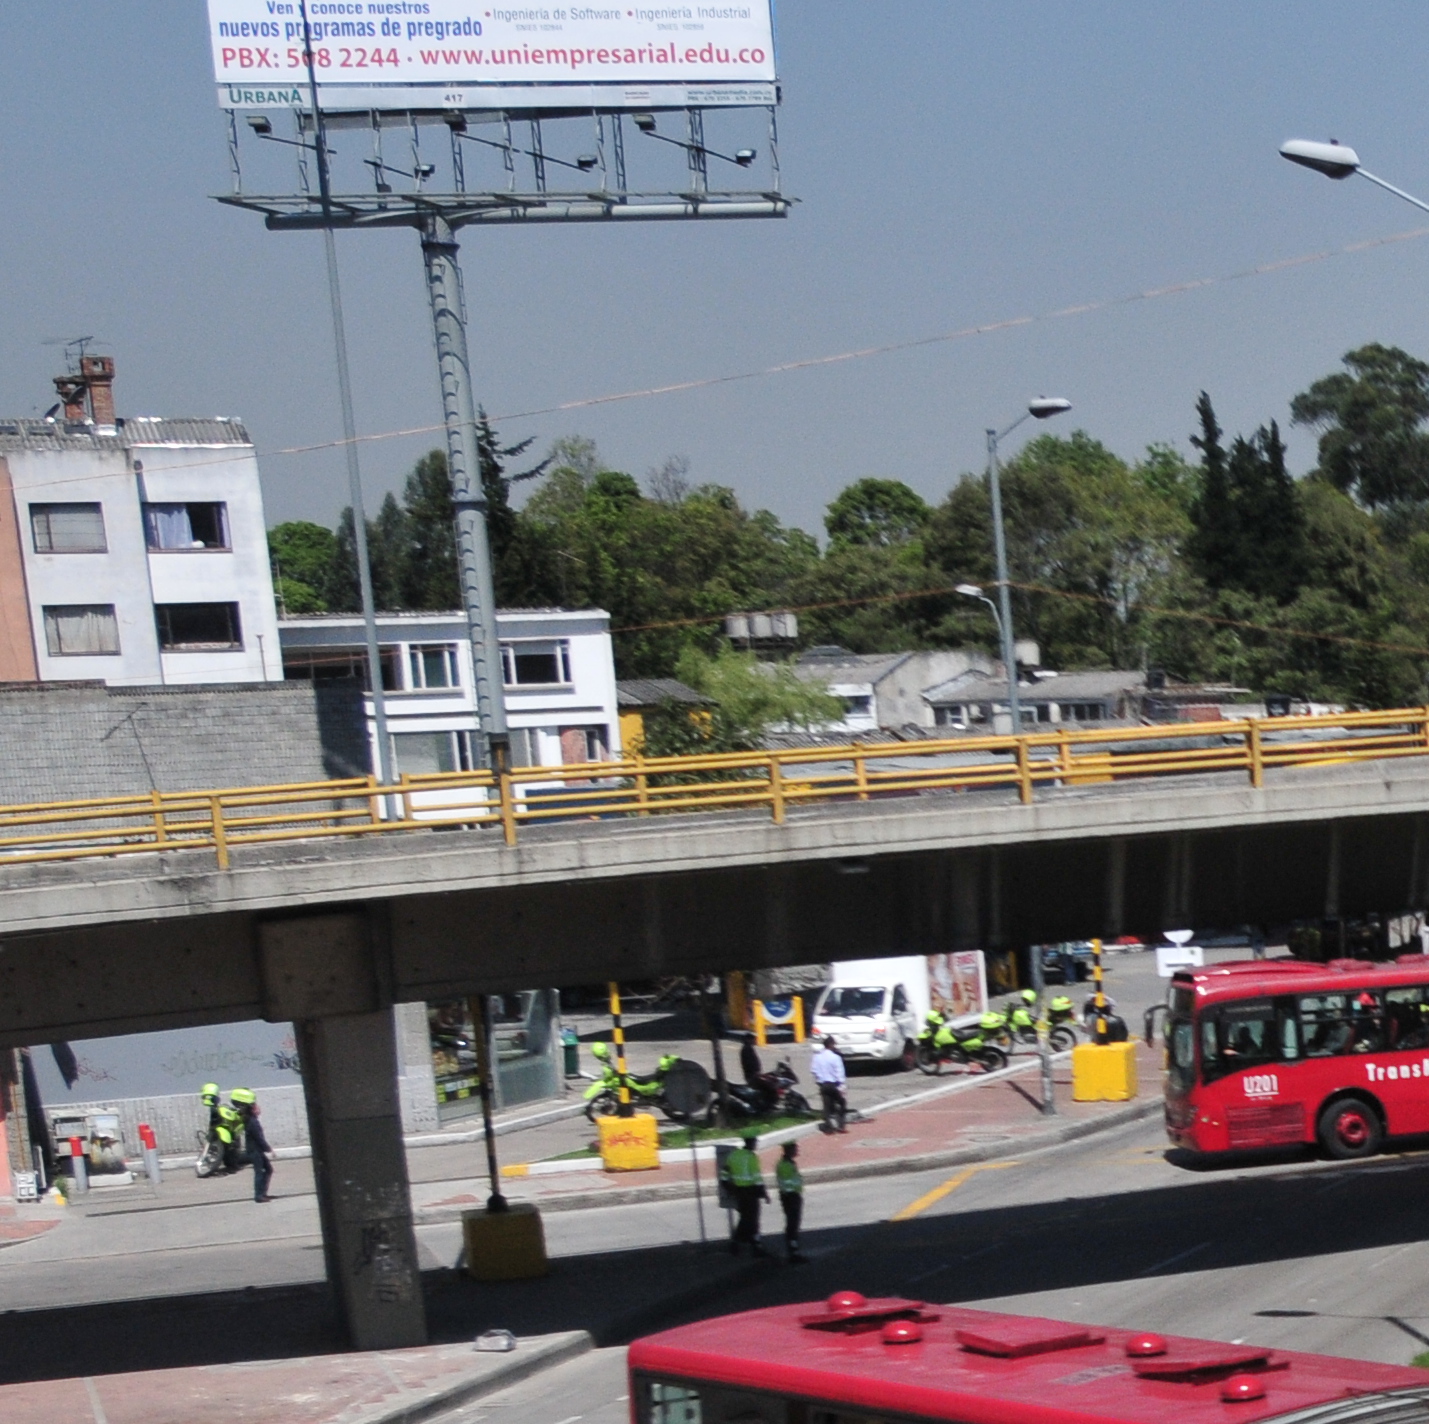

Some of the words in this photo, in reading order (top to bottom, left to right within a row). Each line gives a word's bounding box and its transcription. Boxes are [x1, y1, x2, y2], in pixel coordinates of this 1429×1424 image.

[266, 0, 294, 15] Ven
[311, 3, 363, 15] conoce
[368, 1, 430, 14] nuestros
[553, 8, 567, 20] de
[571, 7, 621, 20] Software
[698, 5, 751, 19] Industrial
[219, 21, 280, 37] nuevos
[381, 17, 402, 37] de
[407, 17, 483, 40] pregrado
[221, 47, 279, 69] PBX:
[338, 47, 400, 68] 2244
[420, 42, 766, 70] www.uniempresarial.edu.co
[228, 87, 304, 104] URBANA
[444, 94, 463, 102] 417
[1243, 1074, 1278, 1093] U201
